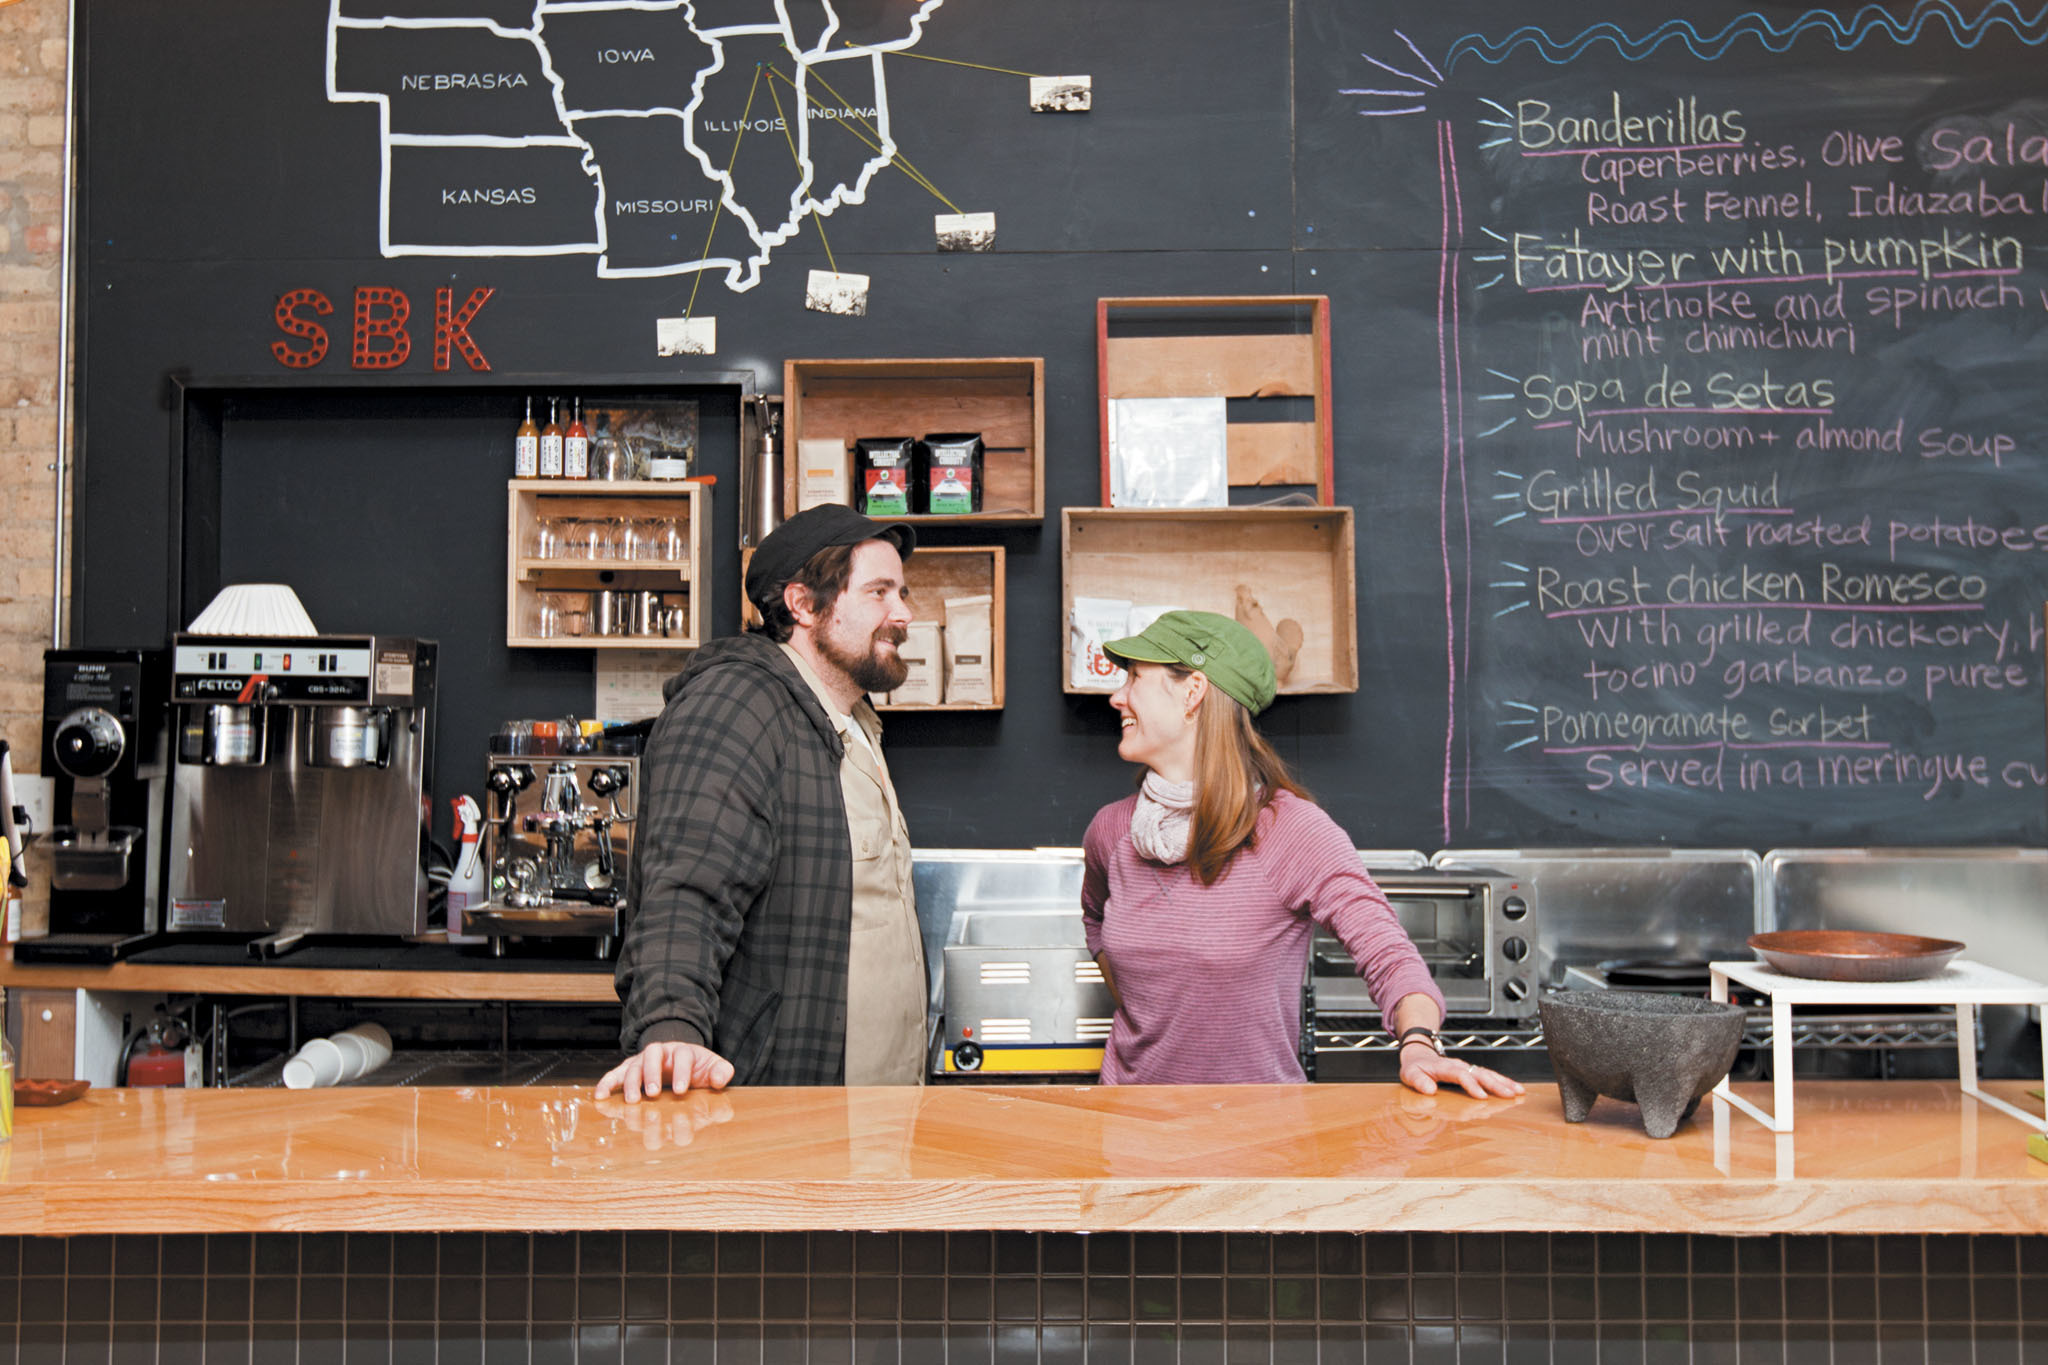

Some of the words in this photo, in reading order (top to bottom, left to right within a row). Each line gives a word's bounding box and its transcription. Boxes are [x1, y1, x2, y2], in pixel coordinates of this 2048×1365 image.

[597, 48, 656, 64] IOWA
[401, 73, 528, 91] NEBRASKA
[704, 119, 787, 132] ILLINOIS
[807, 107, 878, 120] INDIANA
[1517, 91, 1746, 148] Banderillas
[1821, 130, 1904, 168] Olive
[442, 187, 537, 205] KANSAS
[616, 199, 713, 216] MISSOURI
[1588, 188, 1688, 226] Roast
[1513, 228, 1696, 293] Fatayer
[1711, 229, 1804, 275] with
[1824, 226, 2023, 286] pumpkin
[1580, 285, 1757, 328] Artichoke
[1774, 280, 1846, 321] and
[1865, 276, 2024, 329] spinach
[272, 286, 496, 371] SBK
[1582, 323, 1665, 364] mint
[1685, 320, 1856, 355] chimichuri
[1523, 374, 1626, 429] Sopa
[1644, 363, 1696, 409] de
[1706, 368, 1836, 412] Setas
[1576, 417, 1755, 459] Mushroom
[1796, 417, 1904, 453] almond
[1918, 427, 2017, 469] soup
[1527, 464, 1658, 520] Grilled
[1676, 469, 1780, 524] Squid
[1663, 515, 1732, 551] salt
[1746, 514, 1872, 549] roasted
[1537, 564, 1651, 611] Roast
[1822, 562, 1988, 604] Romesco
[1696, 609, 1813, 667] grilled
[198, 679, 243, 692] FETCO
[1583, 659, 1696, 701] tocino
[1723, 651, 1908, 699] garbanzo
[1925, 663, 2029, 701] puree
[1543, 703, 1751, 751] Pomegranate
[1768, 703, 1875, 743] Sorbet
[1585, 746, 1725, 793] Served
[1739, 753, 1772, 791] in
[1781, 760, 1805, 789] a
[1818, 750, 1990, 801] meringue
